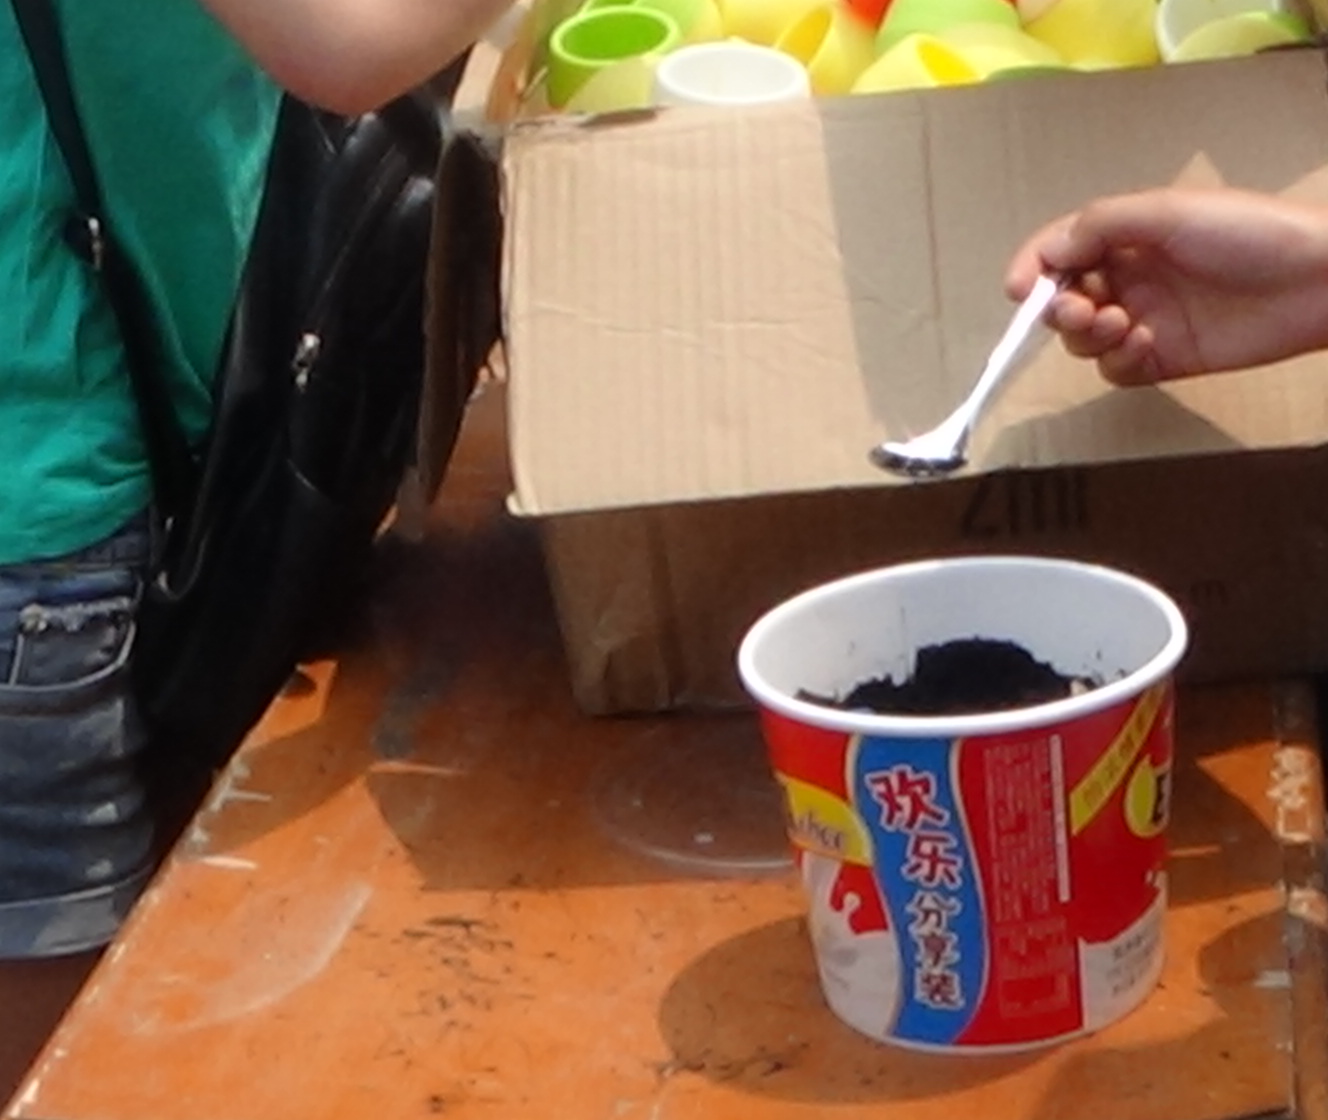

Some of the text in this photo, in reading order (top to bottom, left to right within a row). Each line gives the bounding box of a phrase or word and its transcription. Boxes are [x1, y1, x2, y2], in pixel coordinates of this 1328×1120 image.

[865, 764, 965, 1010] 欢乐分享装
